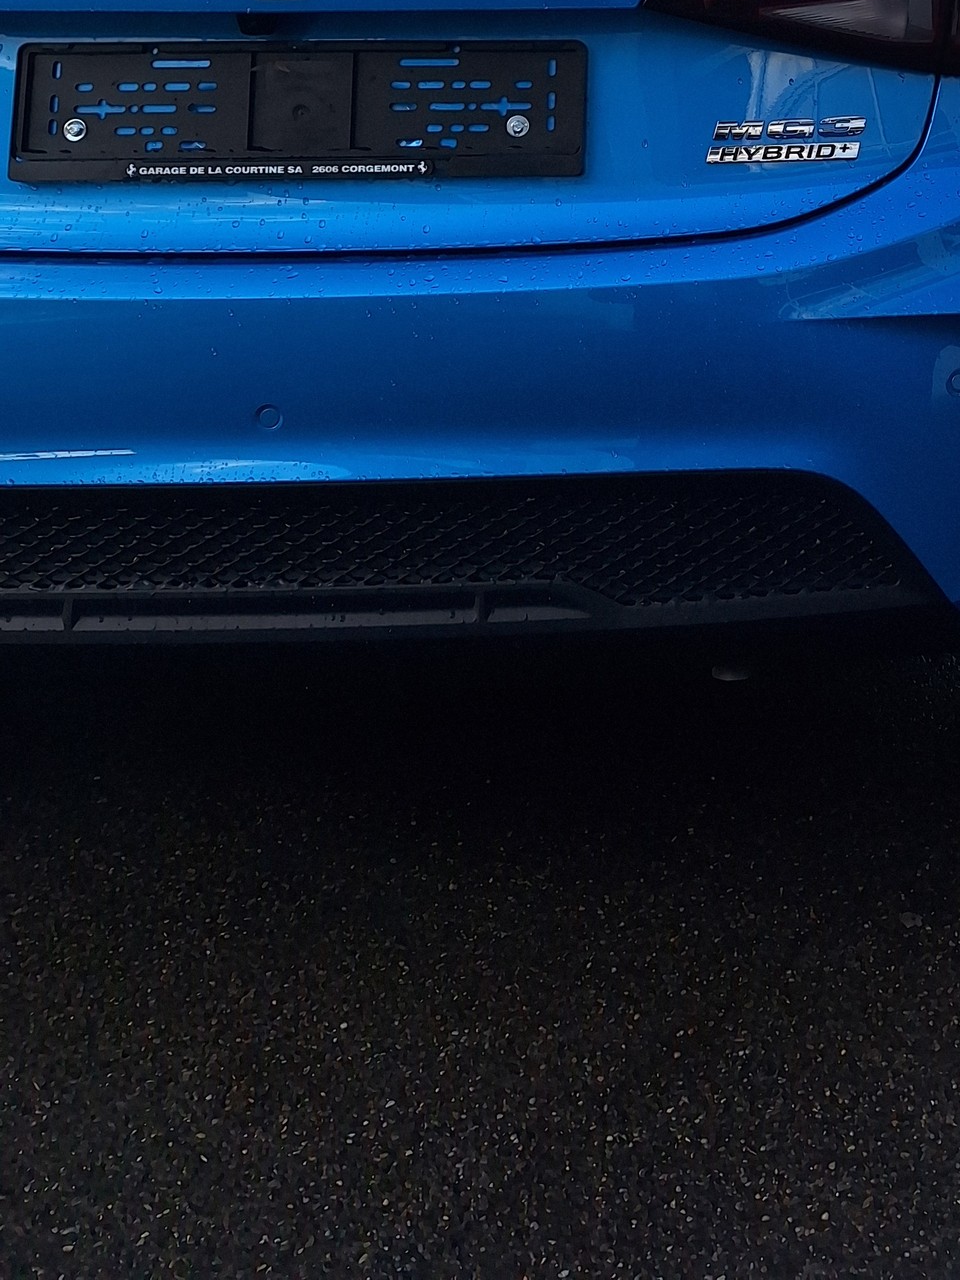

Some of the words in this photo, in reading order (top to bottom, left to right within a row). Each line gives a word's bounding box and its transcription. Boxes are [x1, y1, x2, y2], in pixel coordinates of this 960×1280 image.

[712, 115, 867, 141] MG3
[718, 143, 851, 162] HYBRID+
[139, 166, 187, 175] GARAGE
[189, 166, 205, 175] DE
[208, 166, 223, 175] LA
[225, 165, 285, 175] COURTINE
[287, 165, 303, 174] SA
[312, 165, 339, 174] 2606
[341, 164, 415, 174] CORGEMONT
